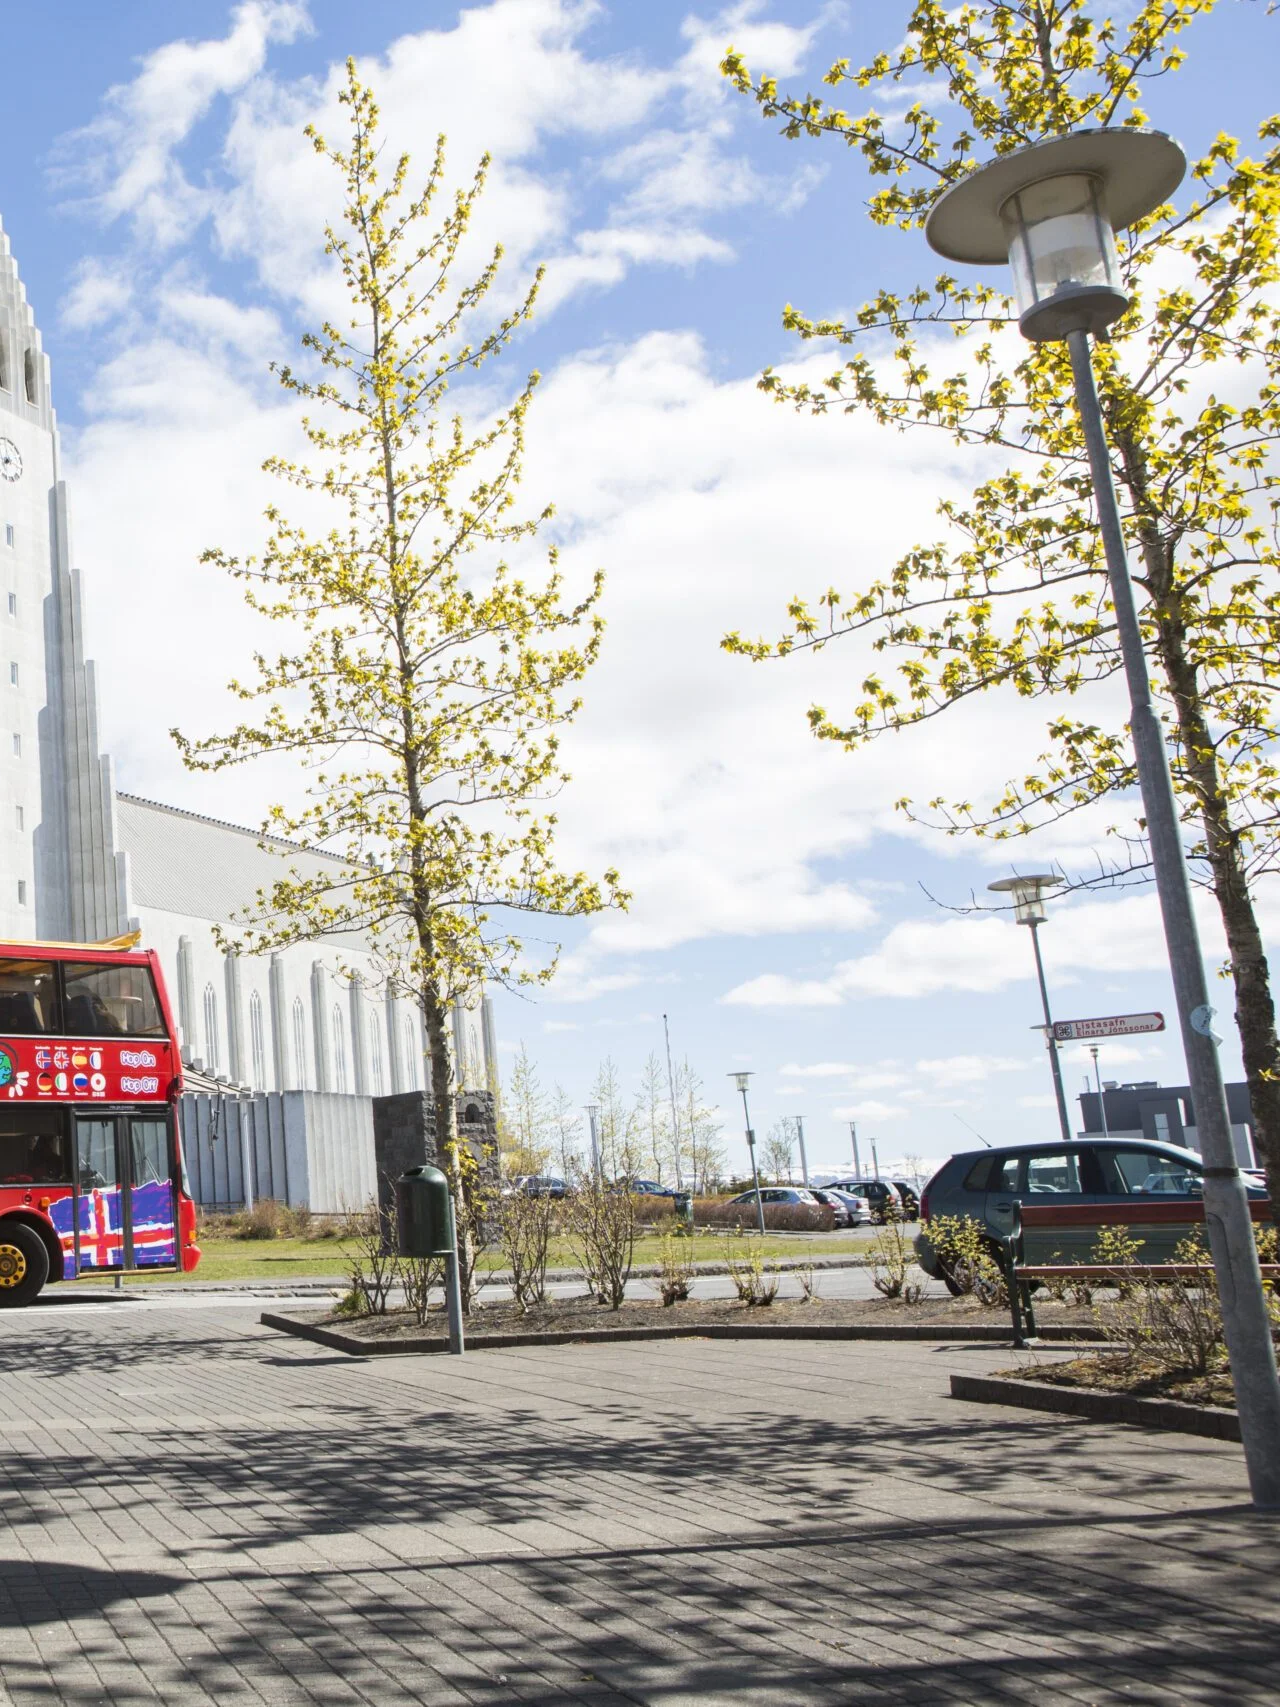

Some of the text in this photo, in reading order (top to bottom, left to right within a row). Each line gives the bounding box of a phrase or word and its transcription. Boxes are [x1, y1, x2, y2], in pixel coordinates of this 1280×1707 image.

[1075, 1019, 1126, 1030] Listasafn
[1076, 1028, 1105, 1037] Einars
[120, 1050, 156, 1068] Hop On
[121, 1076, 158, 1094] Hop Off
